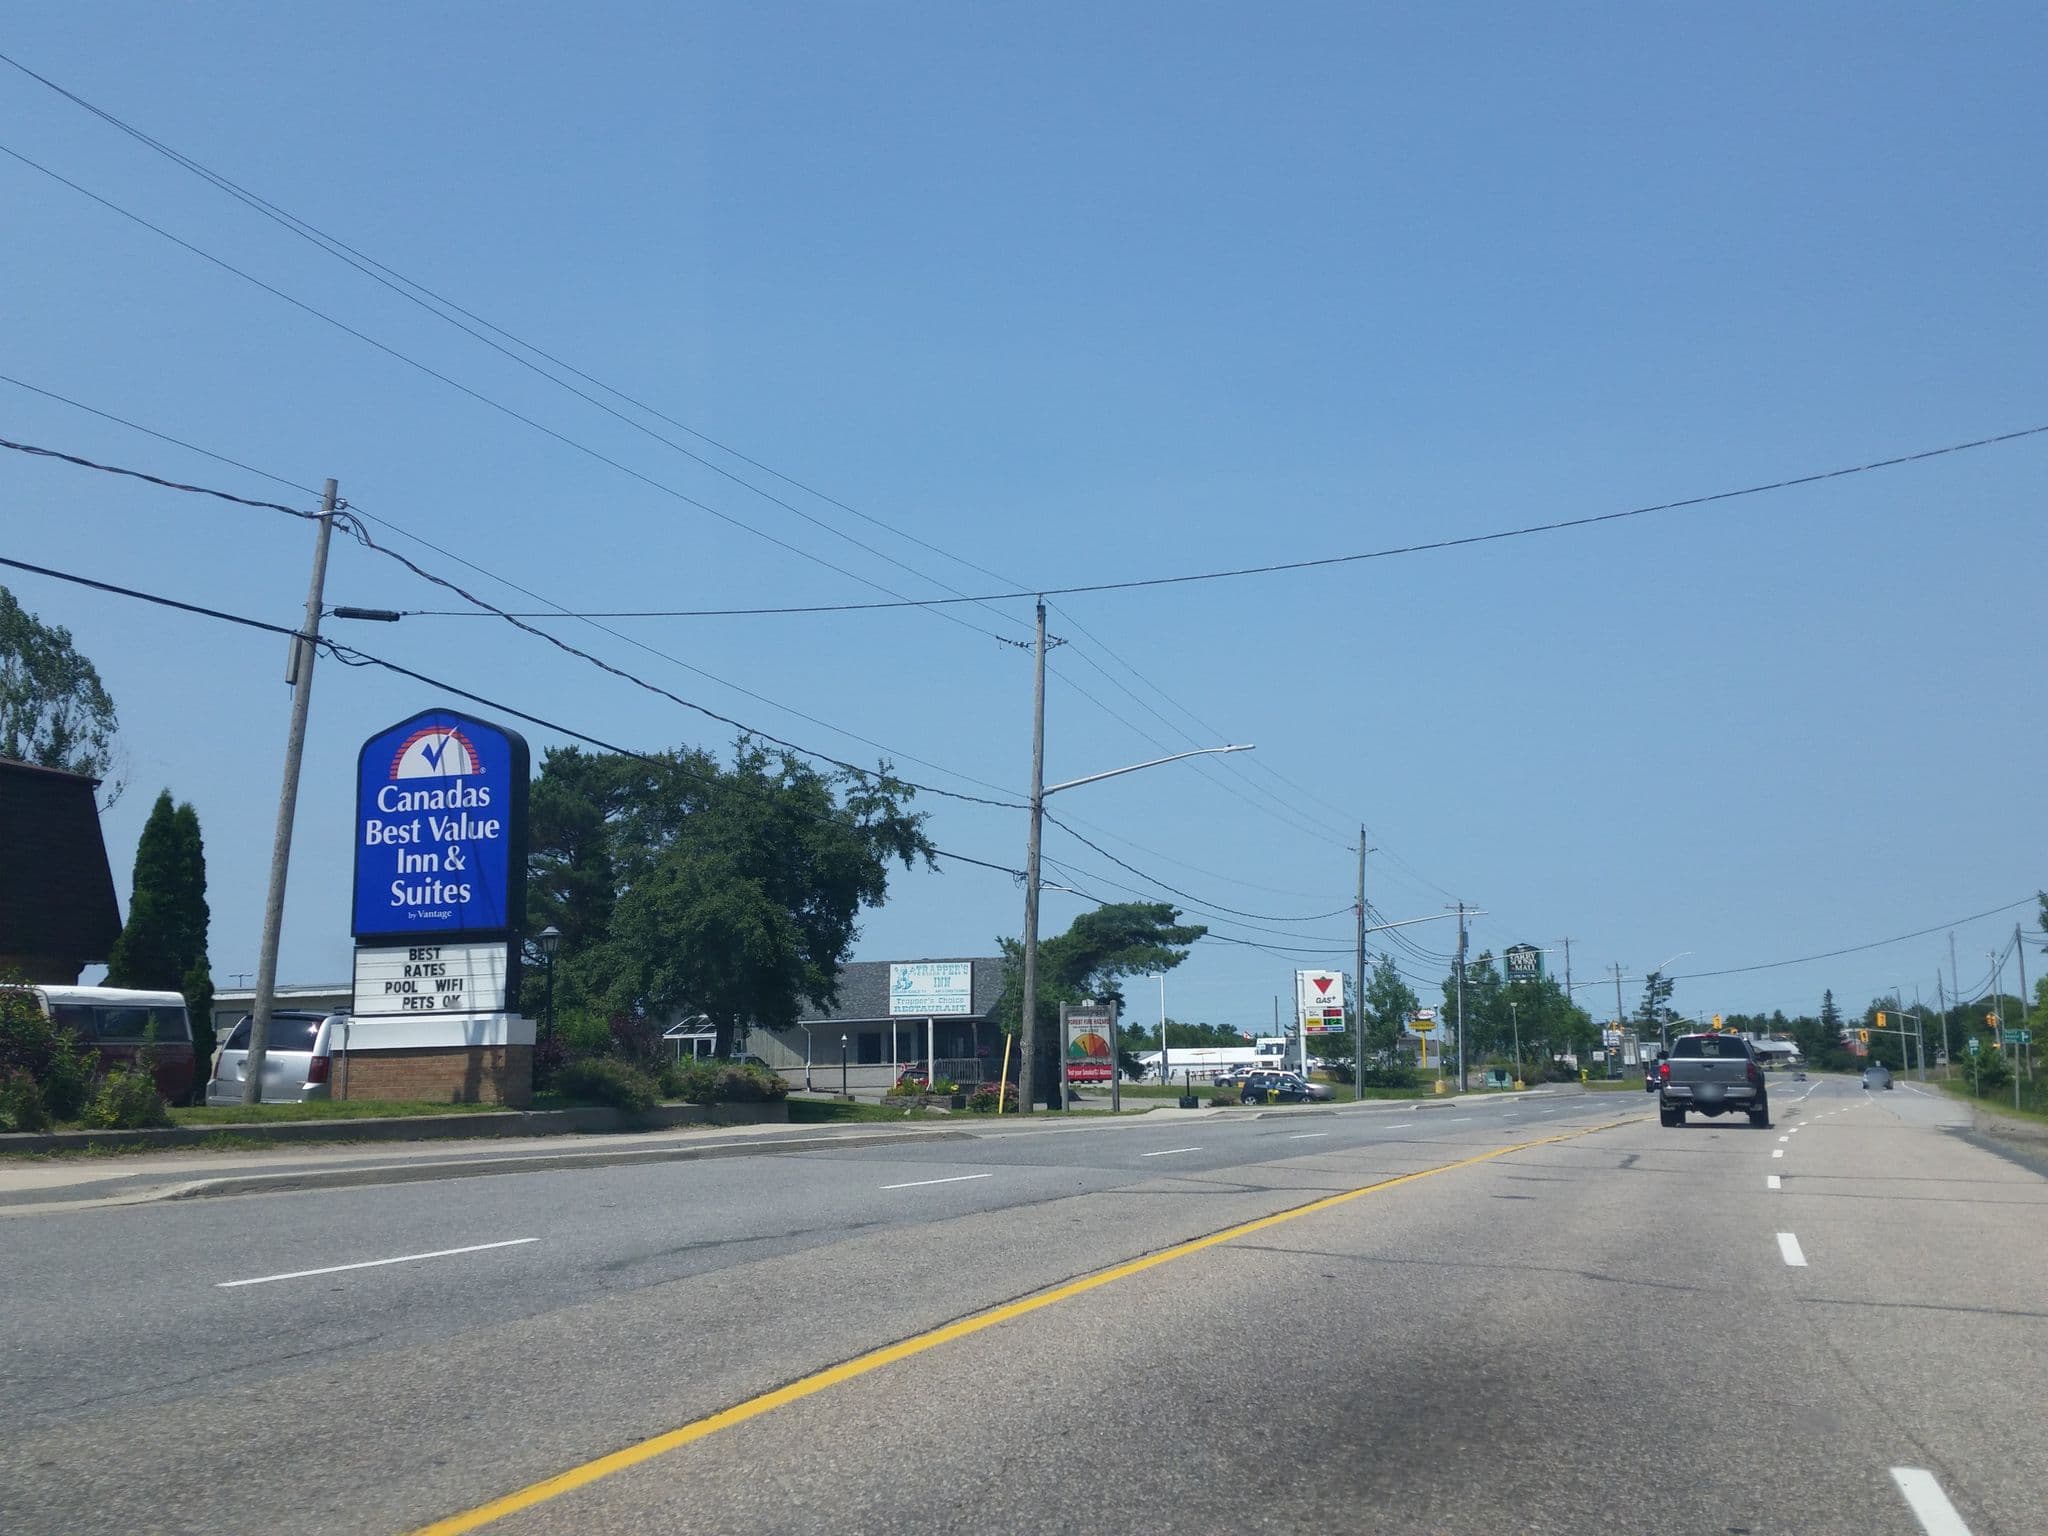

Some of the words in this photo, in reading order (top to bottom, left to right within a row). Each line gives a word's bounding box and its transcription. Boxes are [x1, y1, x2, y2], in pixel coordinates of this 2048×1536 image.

[377, 779, 491, 813] Canadas
[365, 818, 421, 845] Best
[428, 812, 500, 842] Value
[397, 848, 439, 874] Inn
[443, 845, 466, 872] &
[390, 876, 472, 907] Suites
[408, 911, 417, 920] by
[417, 909, 452, 919] Vantage
[409, 947, 441, 961] BEST
[404, 963, 446, 977] RATES
[915, 964, 969, 976] TRAPPER'S
[384, 980, 418, 994] POOL
[435, 978, 463, 992] WIFI
[934, 977, 951, 988] INN
[402, 996, 434, 1009] PETS
[894, 1005, 966, 1013] RESTAURANT
